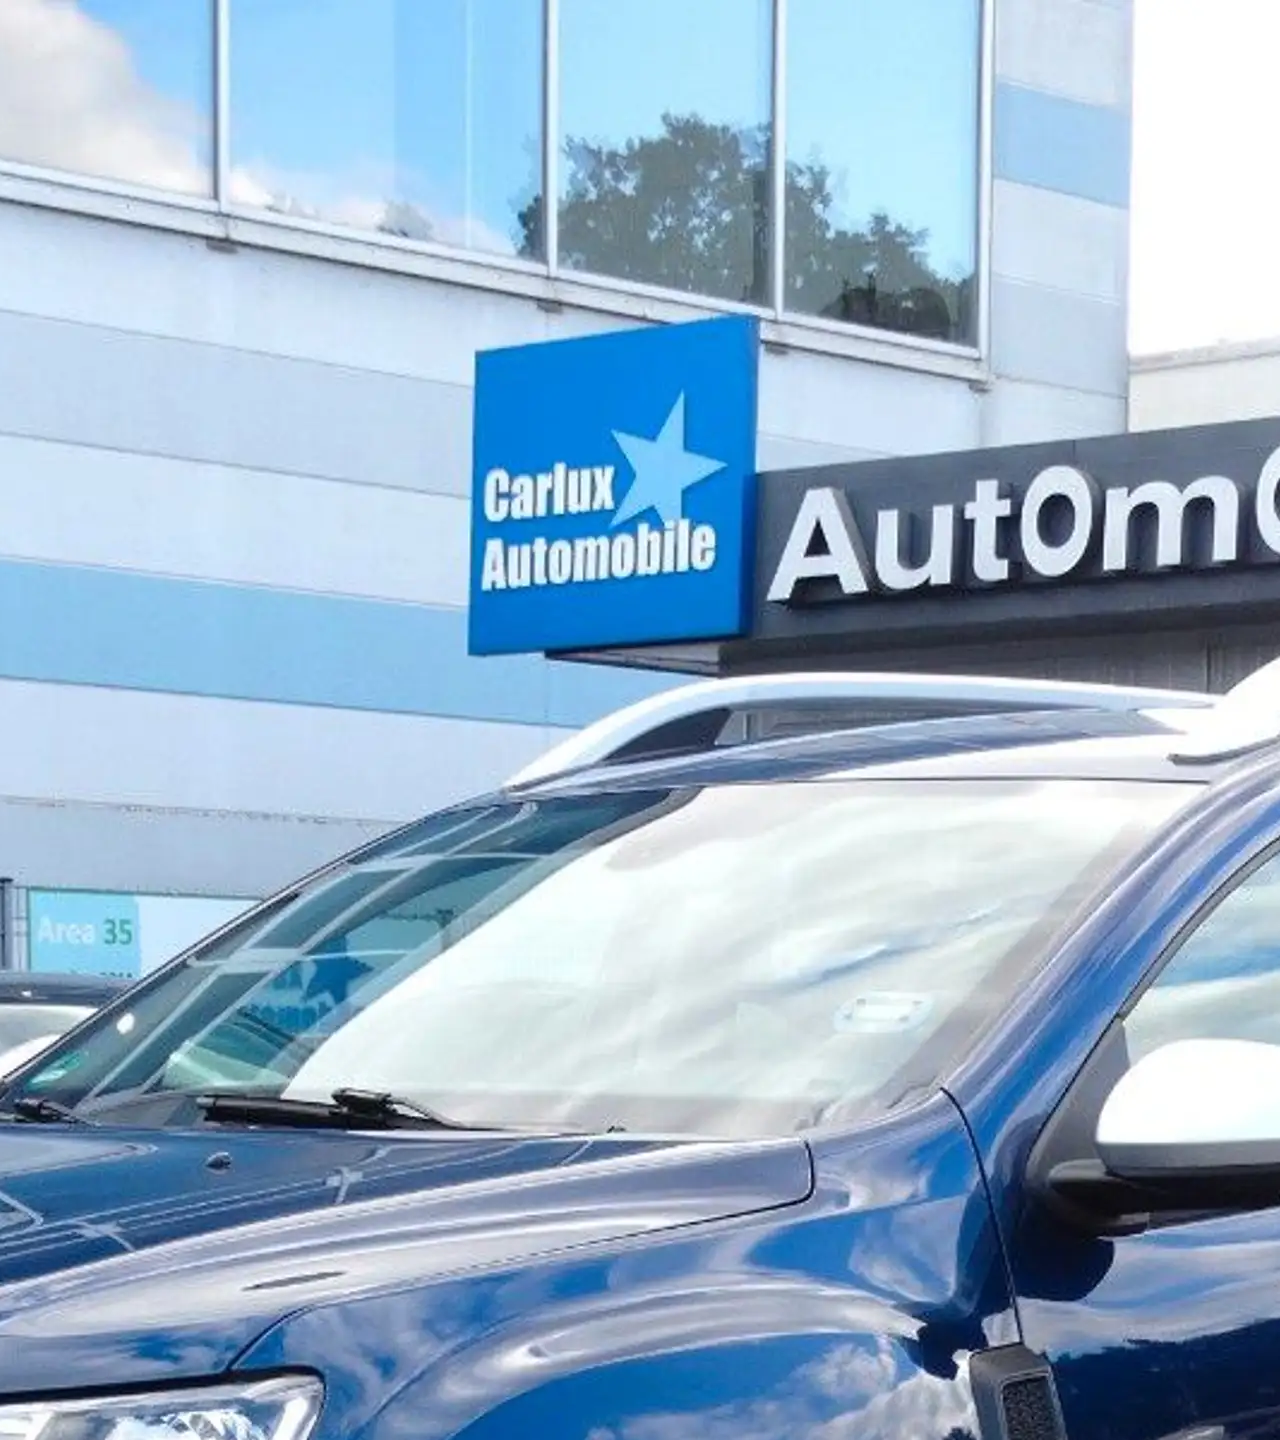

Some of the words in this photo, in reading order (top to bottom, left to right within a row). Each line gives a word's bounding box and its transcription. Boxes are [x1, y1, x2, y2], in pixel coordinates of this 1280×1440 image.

[483, 462, 615, 522] Carlux
[481, 518, 716, 591] Automobile
[37, 917, 96, 945] Area
[103, 919, 133, 945] 35
